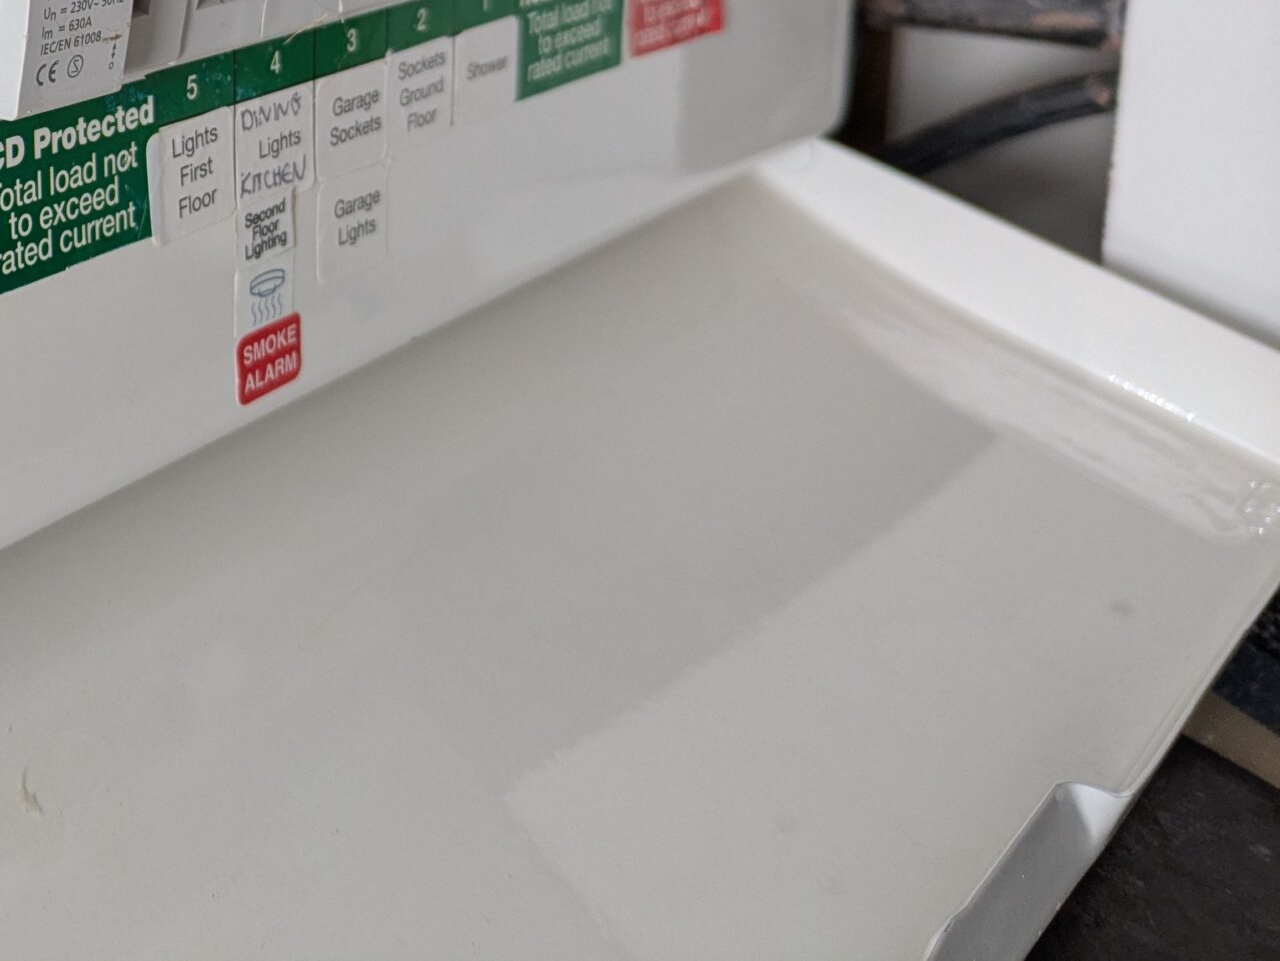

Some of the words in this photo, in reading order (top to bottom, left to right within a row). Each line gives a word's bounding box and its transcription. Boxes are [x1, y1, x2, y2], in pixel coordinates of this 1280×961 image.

[68, 15, 93, 33] 630A
[415, 6, 428, 33] 2
[527, 6, 560, 35] Total
[40, 39, 72, 57] IEC/EN
[73, 29, 103, 49] 61008
[346, 27, 359, 54] 3
[269, 48, 283, 77] 4
[396, 47, 448, 82] Sockets
[465, 52, 510, 84] Shower
[527, 50, 562, 83] rated
[563, 36, 611, 69] current
[185, 72, 200, 102] 5
[331, 87, 381, 118] Garage
[398, 75, 446, 109] Ground
[33, 94, 156, 161] Protected
[328, 112, 383, 148] Sockets
[405, 105, 439, 134] Floor
[171, 124, 220, 161] Lights
[258, 128, 303, 162] Lights
[49, 151, 98, 196] load
[103, 140, 139, 178] not
[179, 155, 215, 189] First
[8, 211, 33, 241] to
[39, 175, 120, 230] exceed
[177, 185, 219, 220] Floor
[243, 196, 288, 230] Second
[333, 186, 382, 221] Garage
[59, 200, 138, 254] current
[251, 215, 281, 243] Floor
[336, 214, 378, 247] Lights
[243, 228, 289, 261] Lighting
[242, 322, 298, 368] SMOKE
[243, 351, 299, 397] ALARM
